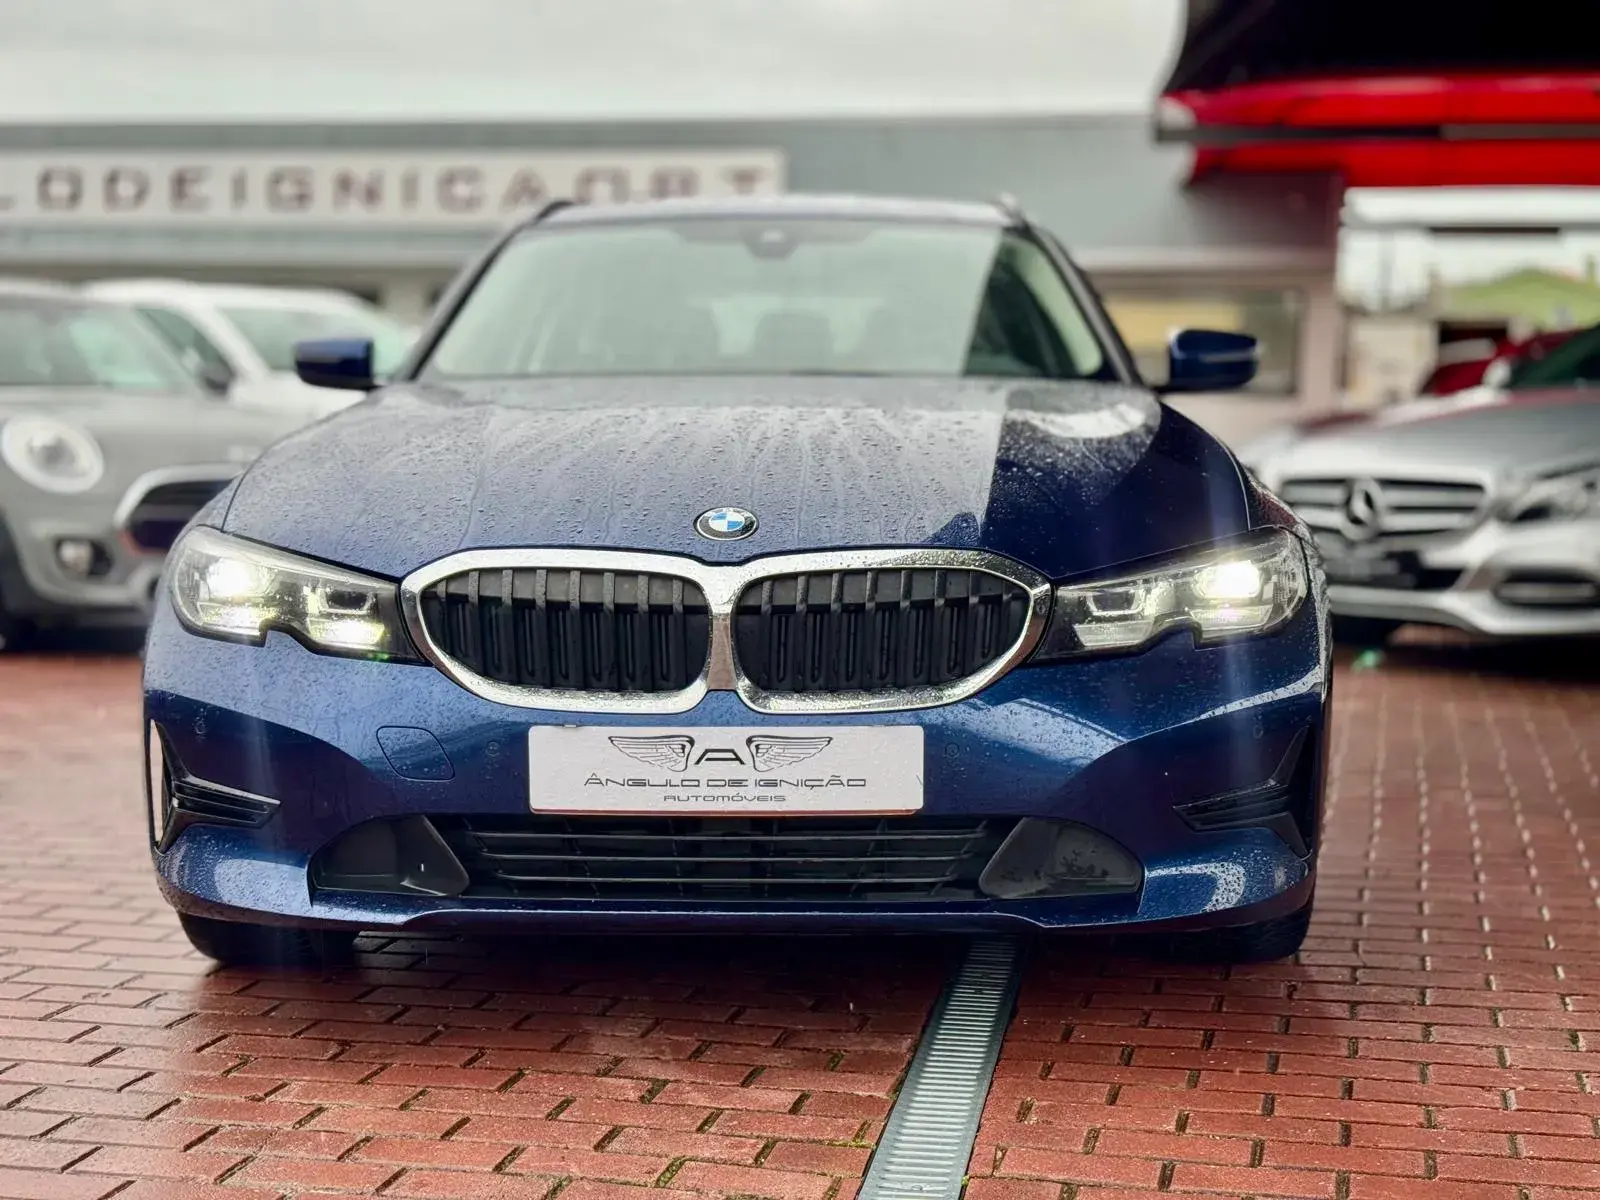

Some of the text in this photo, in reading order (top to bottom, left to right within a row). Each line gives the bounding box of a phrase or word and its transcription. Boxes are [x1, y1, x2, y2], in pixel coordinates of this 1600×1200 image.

[694, 748, 746, 765] A
[584, 772, 866, 790] ÂNGULO DE IGNIÇÃO
[663, 793, 787, 802] AUTOMÓVEIS
